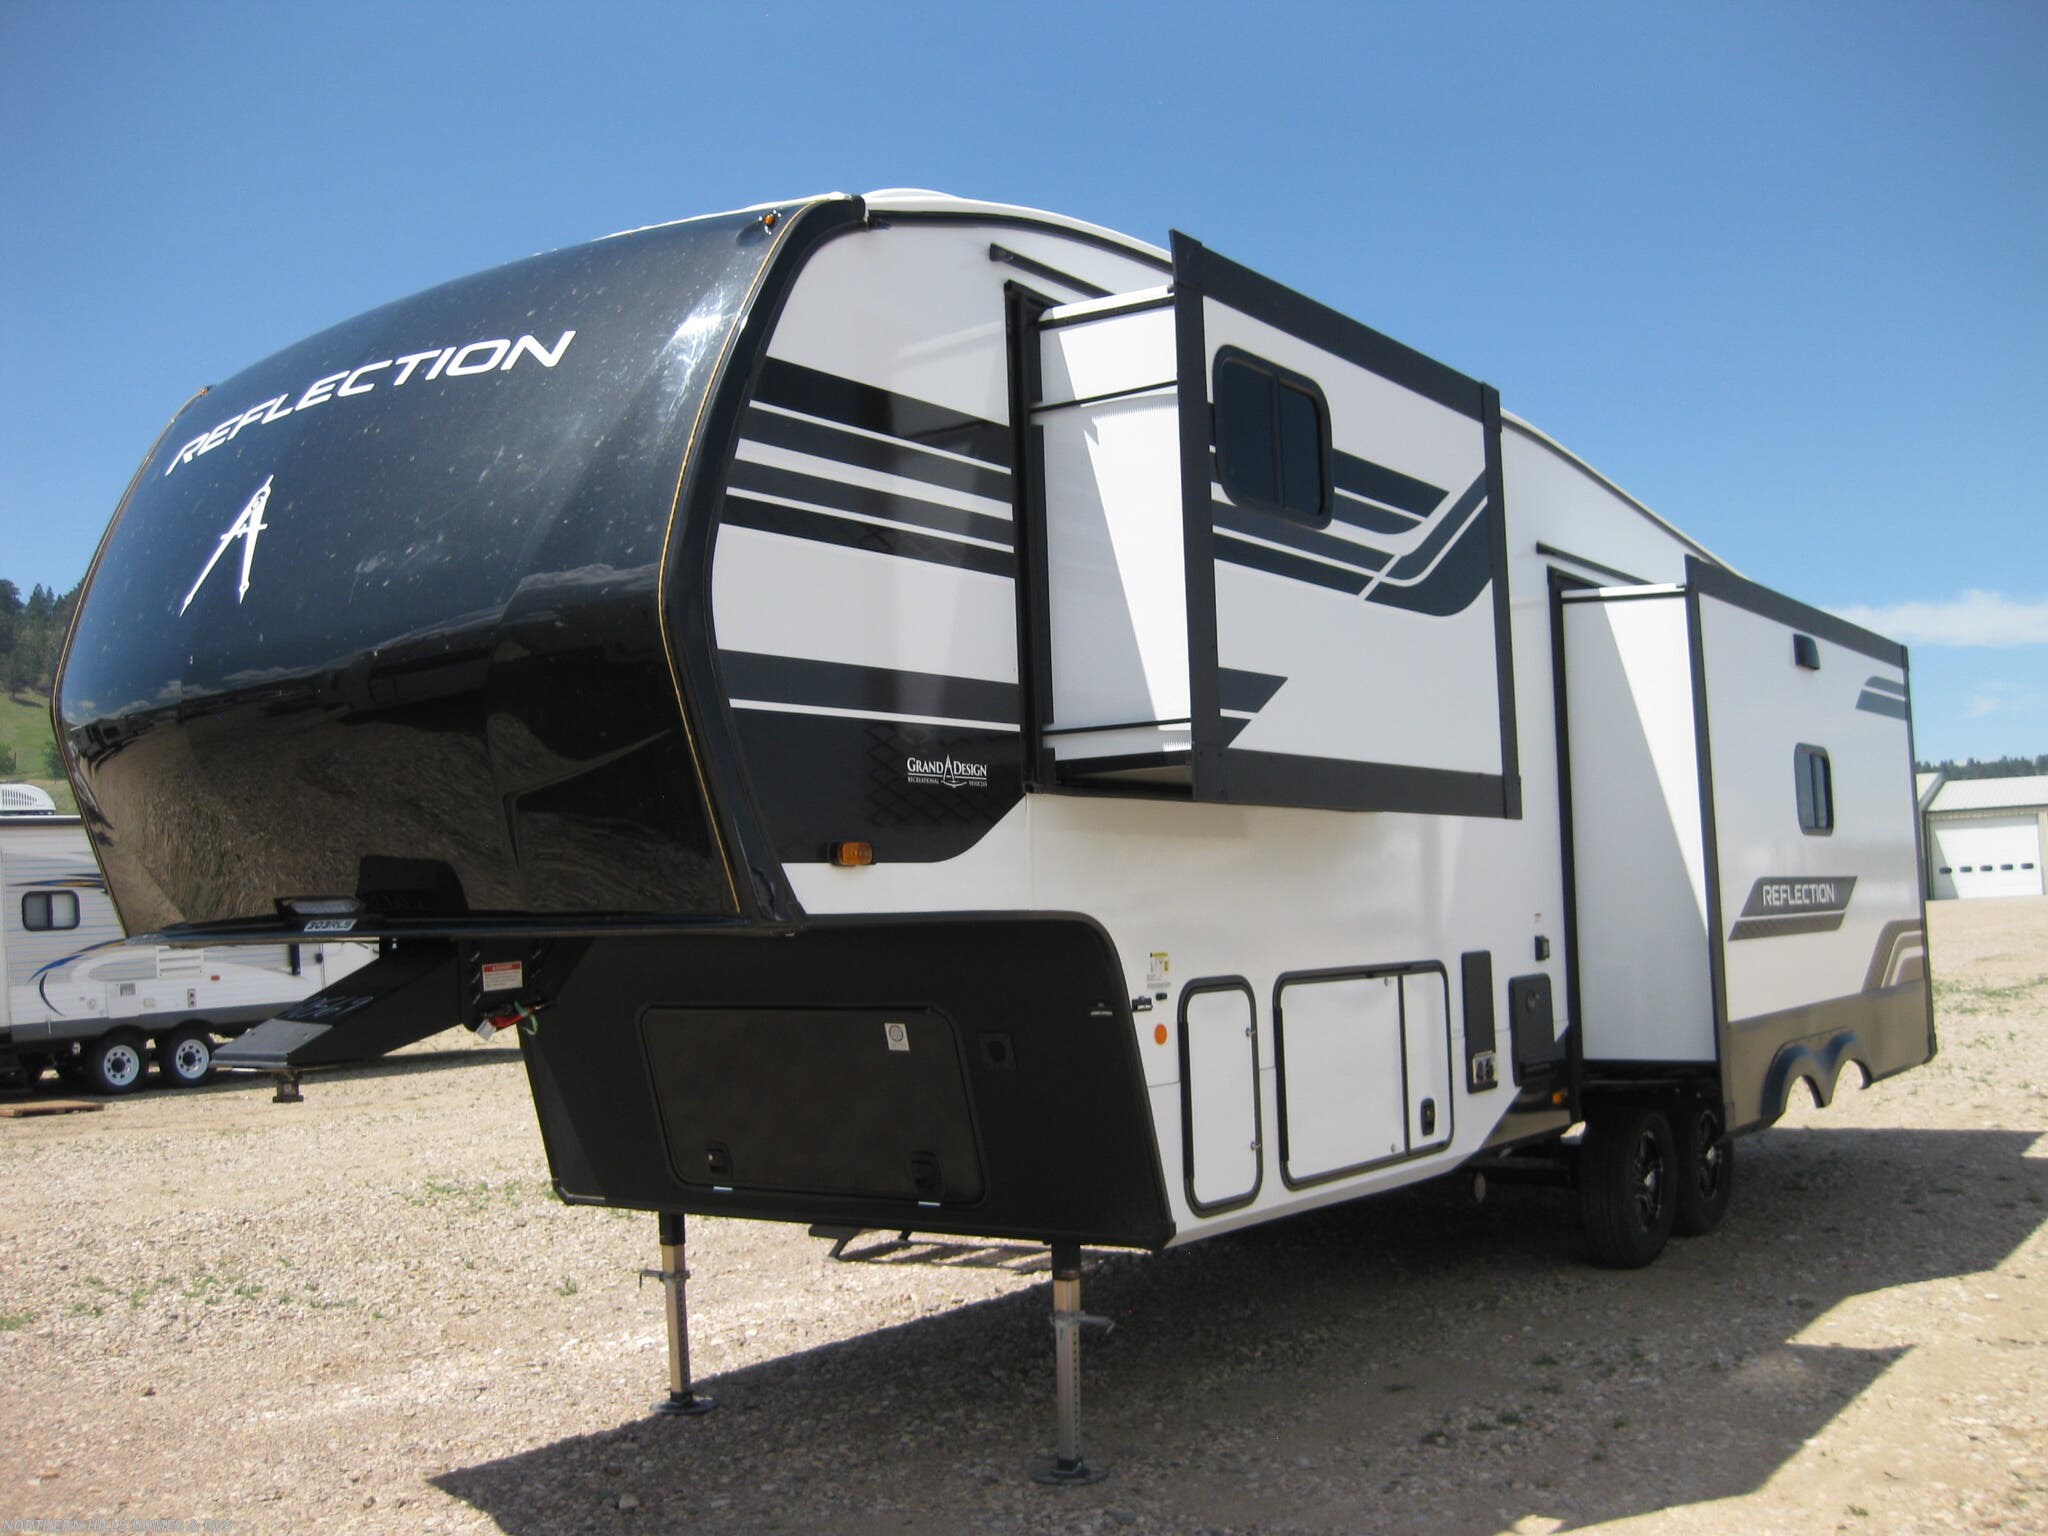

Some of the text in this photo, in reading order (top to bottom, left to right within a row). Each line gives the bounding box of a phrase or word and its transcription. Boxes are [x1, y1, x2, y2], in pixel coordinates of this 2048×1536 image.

[165, 330, 577, 476] REFLECTION
[907, 756, 987, 777] GRAND DESIGN
[1762, 883, 1835, 907] REFLECTION
